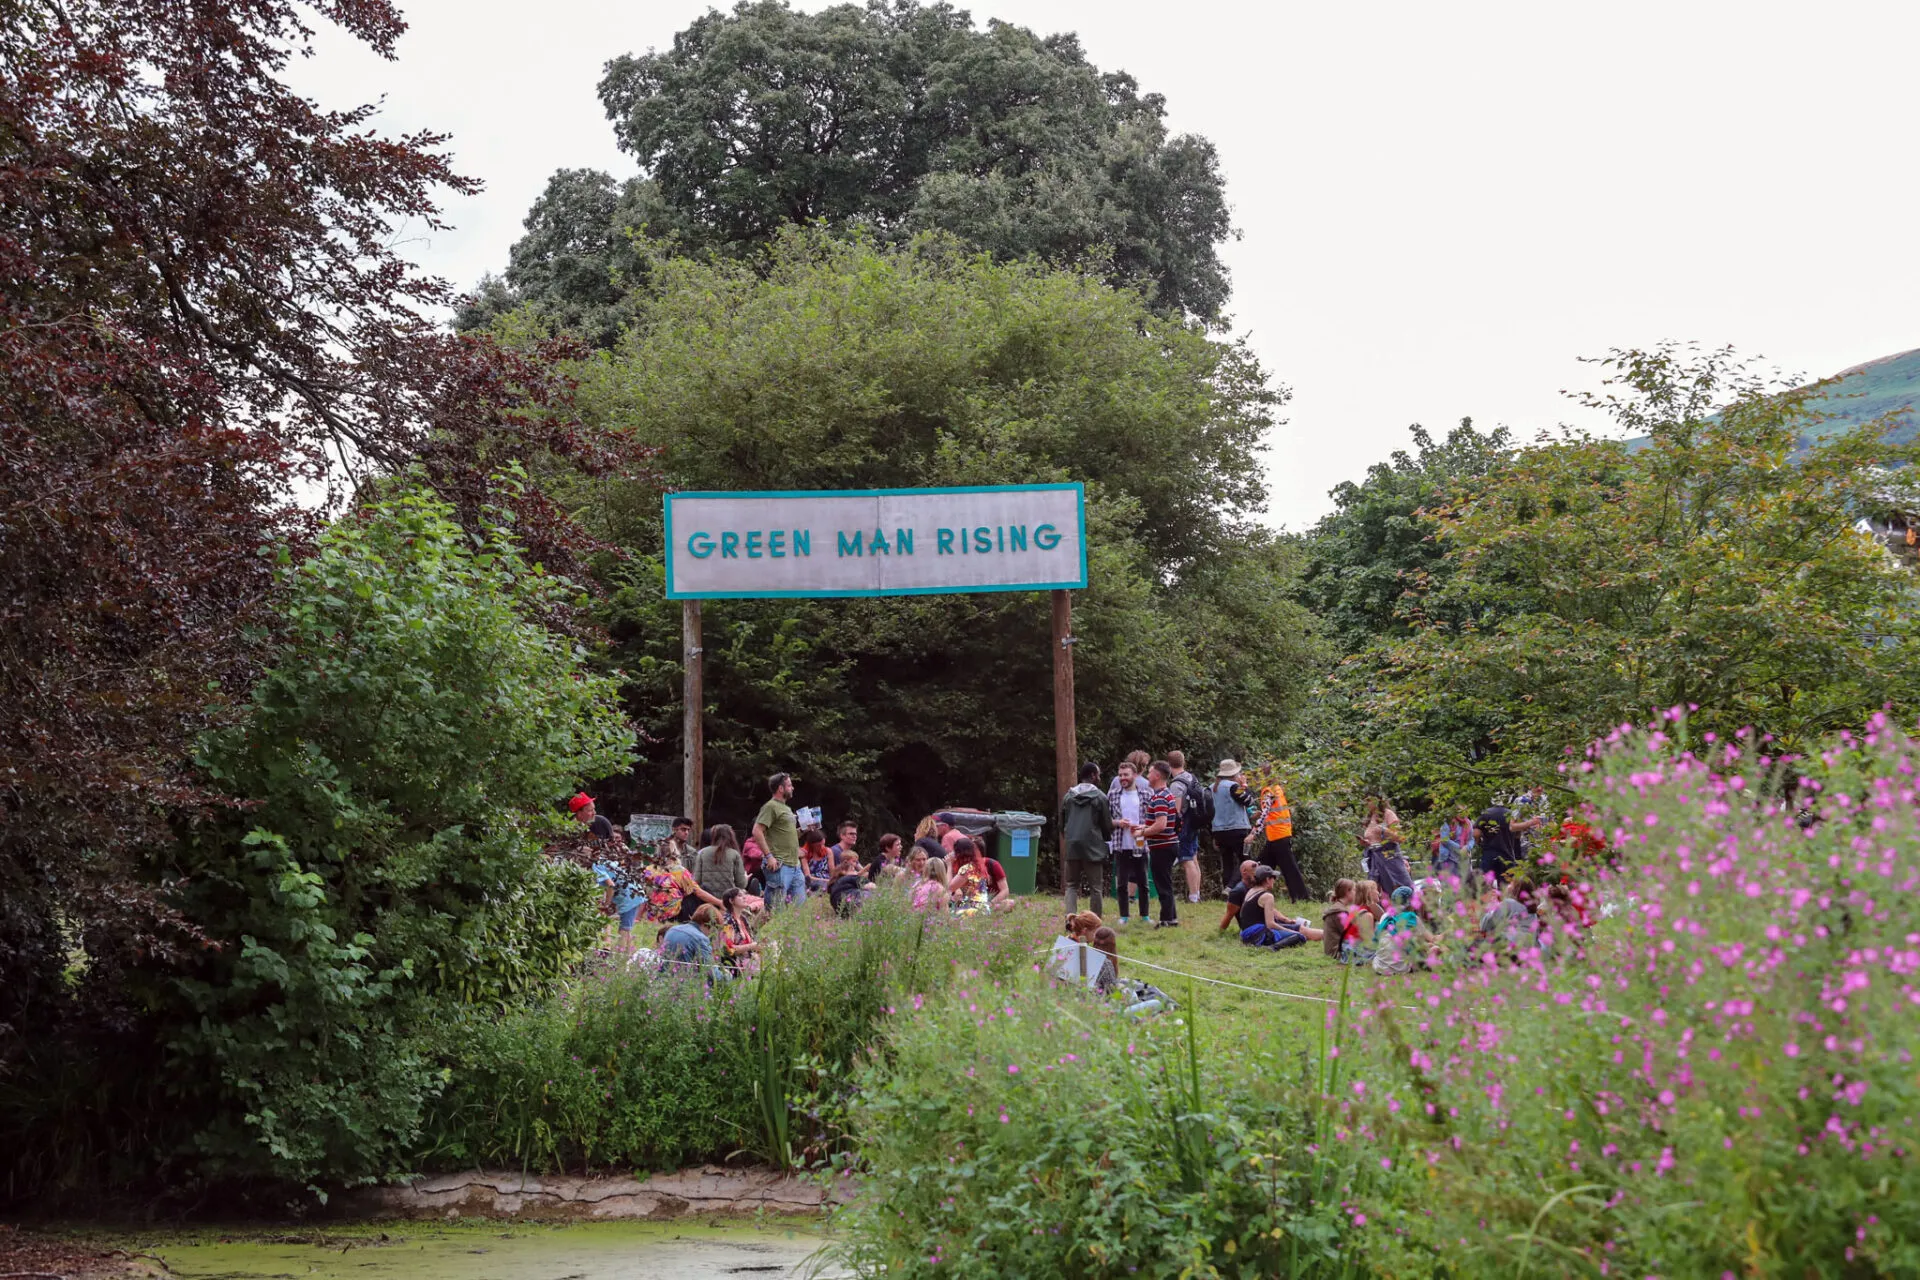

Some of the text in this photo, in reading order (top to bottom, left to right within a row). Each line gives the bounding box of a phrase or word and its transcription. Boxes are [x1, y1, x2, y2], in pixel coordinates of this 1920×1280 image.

[687, 524, 1062, 559] GREEN MAN RISING
